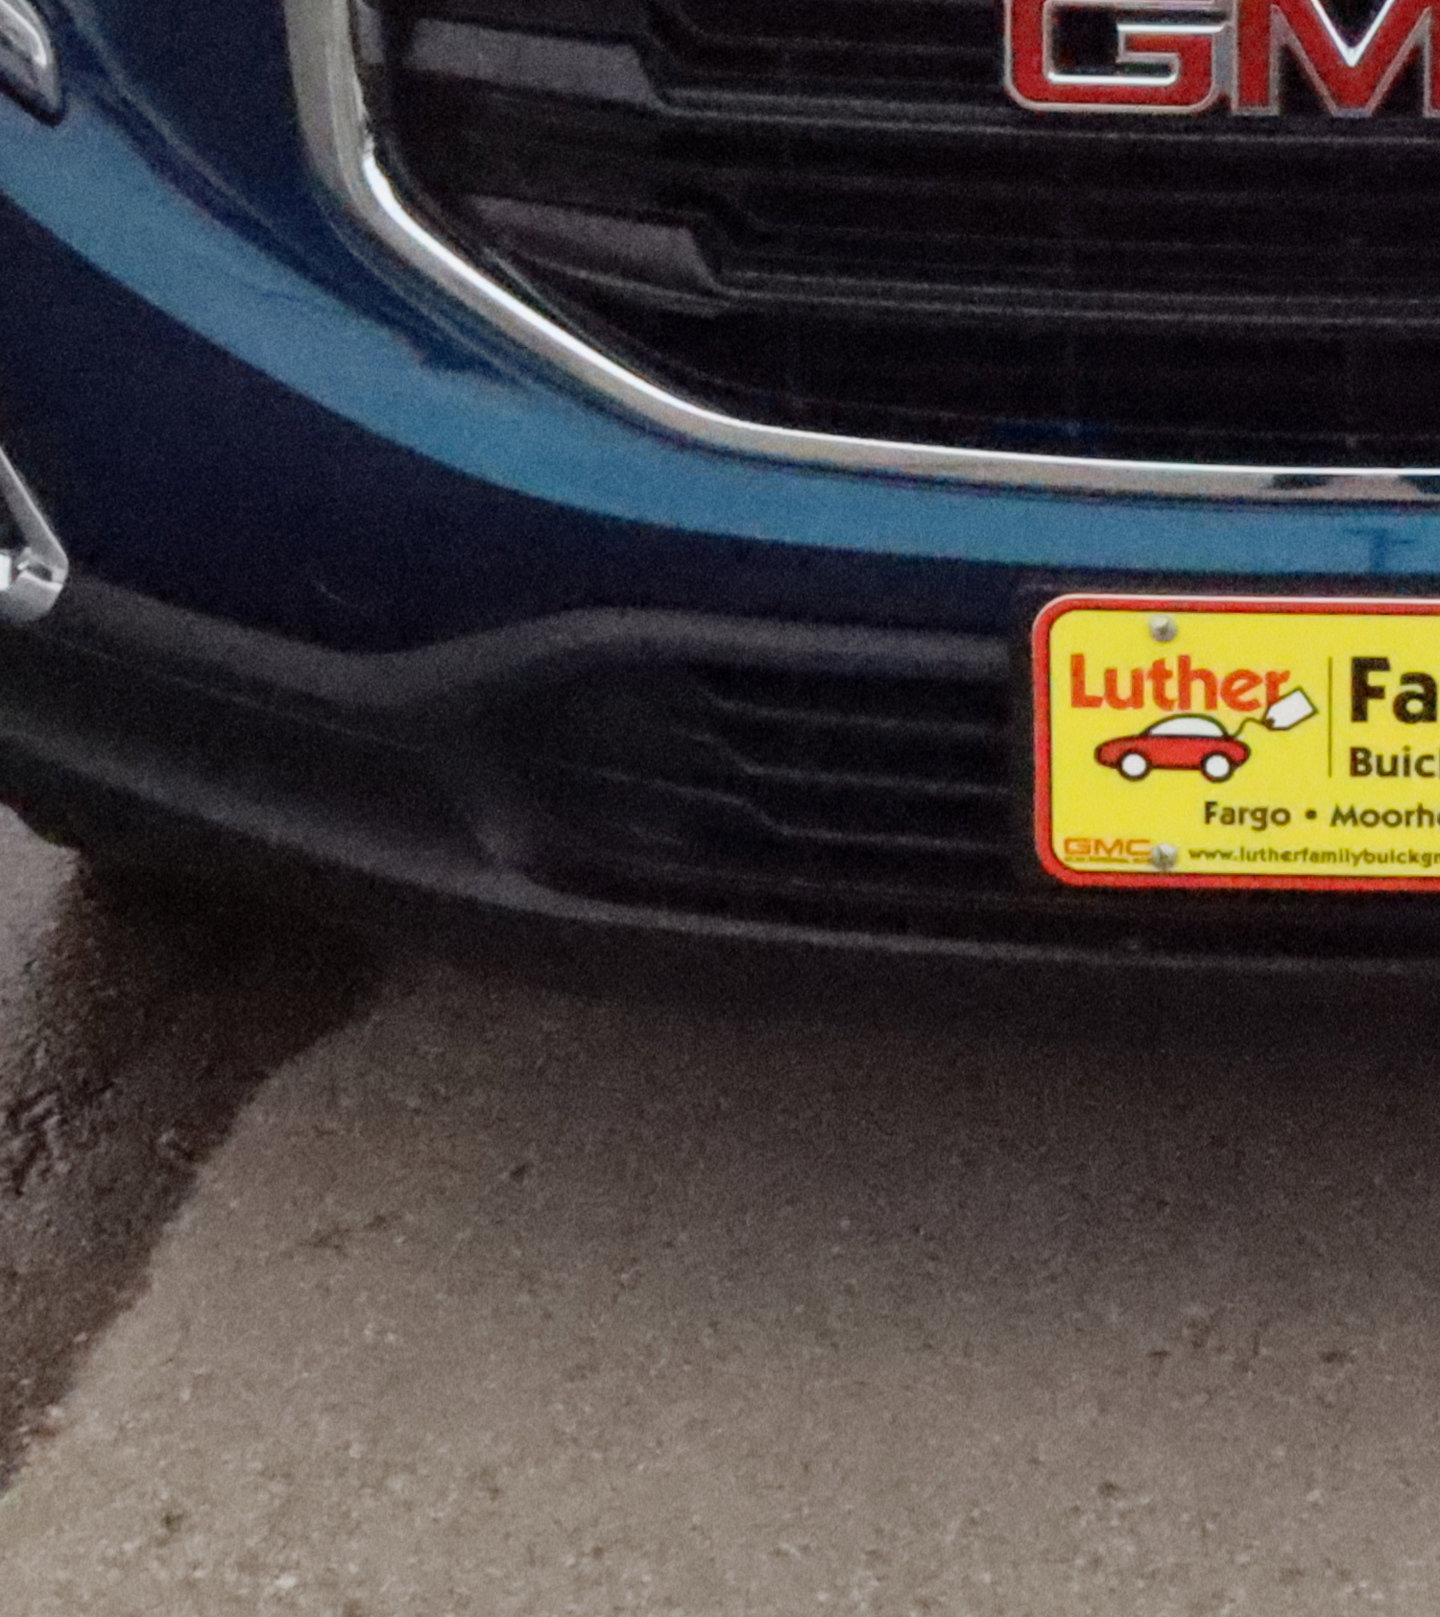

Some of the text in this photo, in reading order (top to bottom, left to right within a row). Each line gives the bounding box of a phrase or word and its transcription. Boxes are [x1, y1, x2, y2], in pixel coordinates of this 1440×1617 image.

[1069, 653, 1291, 713] Luther
[1203, 800, 1292, 833] Fargo
[1063, 837, 1152, 857] GMC
